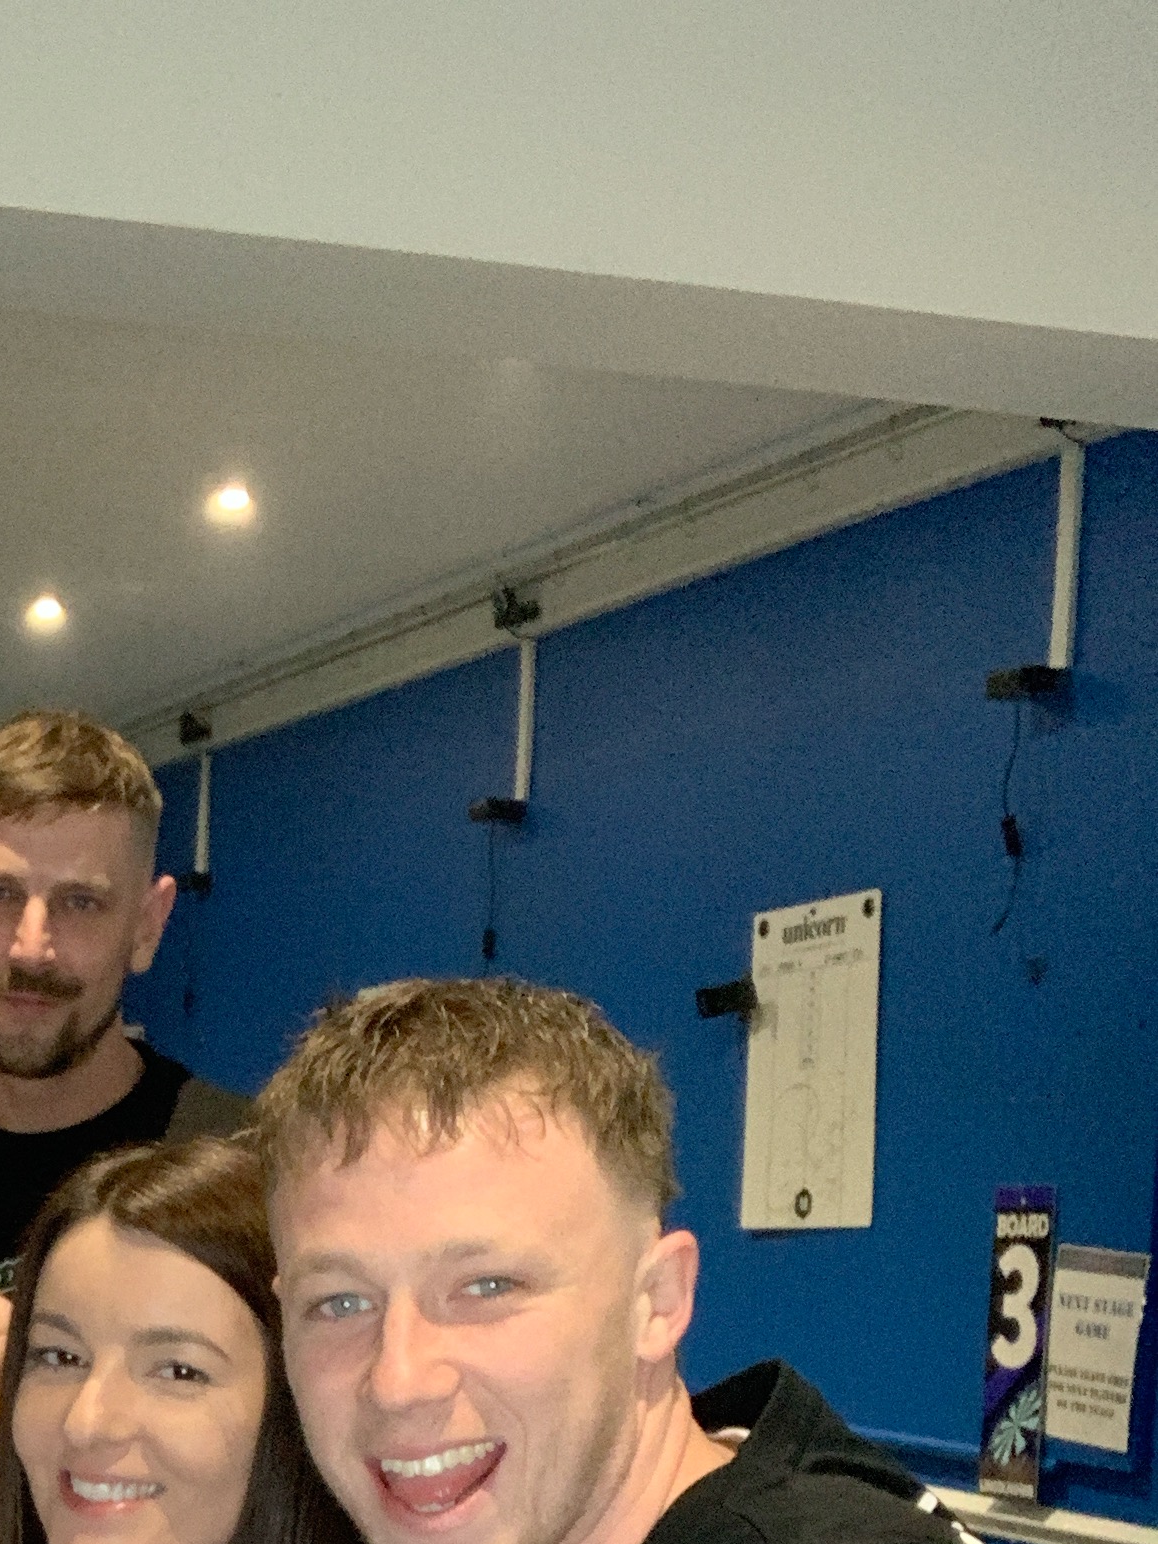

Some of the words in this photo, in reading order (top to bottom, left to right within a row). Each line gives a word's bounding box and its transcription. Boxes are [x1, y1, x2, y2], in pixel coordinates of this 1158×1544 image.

[782, 914, 846, 944] unicorn
[996, 1212, 1049, 1238] BOARD
[991, 1243, 1040, 1369] 3
[1075, 1320, 1109, 1340] GAME
